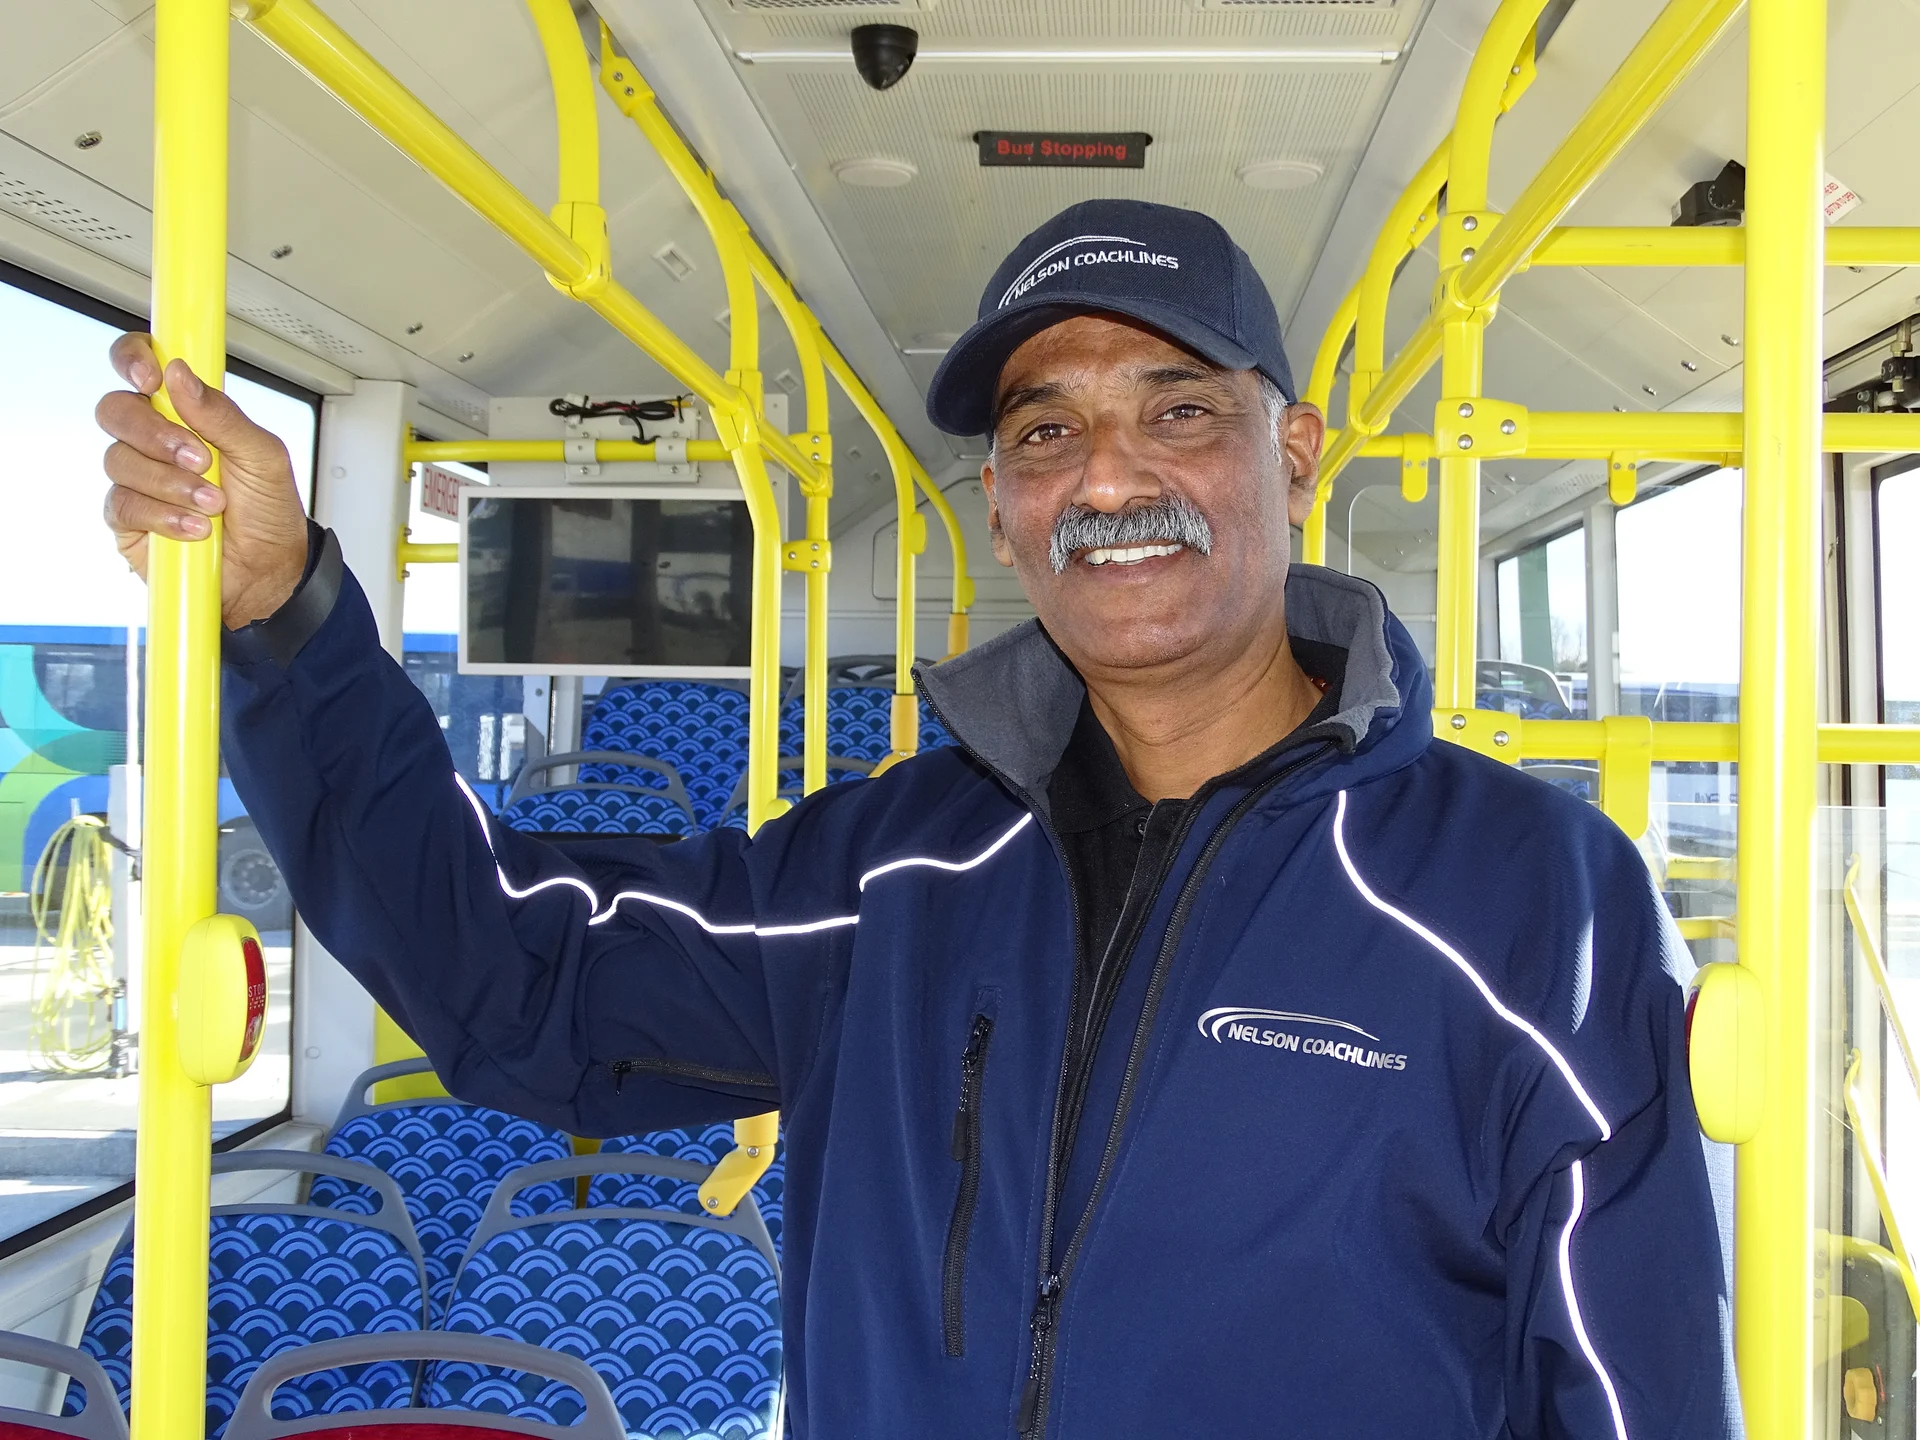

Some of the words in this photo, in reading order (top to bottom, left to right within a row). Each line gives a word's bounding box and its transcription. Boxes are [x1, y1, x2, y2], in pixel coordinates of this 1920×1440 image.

[997, 139, 1034, 155] Bus
[1040, 140, 1127, 160] Stopping
[1824, 202, 1842, 216] BUTTON
[1842, 191, 1855, 202] OPEN
[1014, 256, 1070, 300] NELSON
[1074, 249, 1179, 270] COACHLINES
[424, 467, 464, 517] EMERGE
[248, 983, 265, 998] STOP
[1228, 1022, 1300, 1052] NELSON
[1302, 1038, 1408, 1071] COACHLINES
